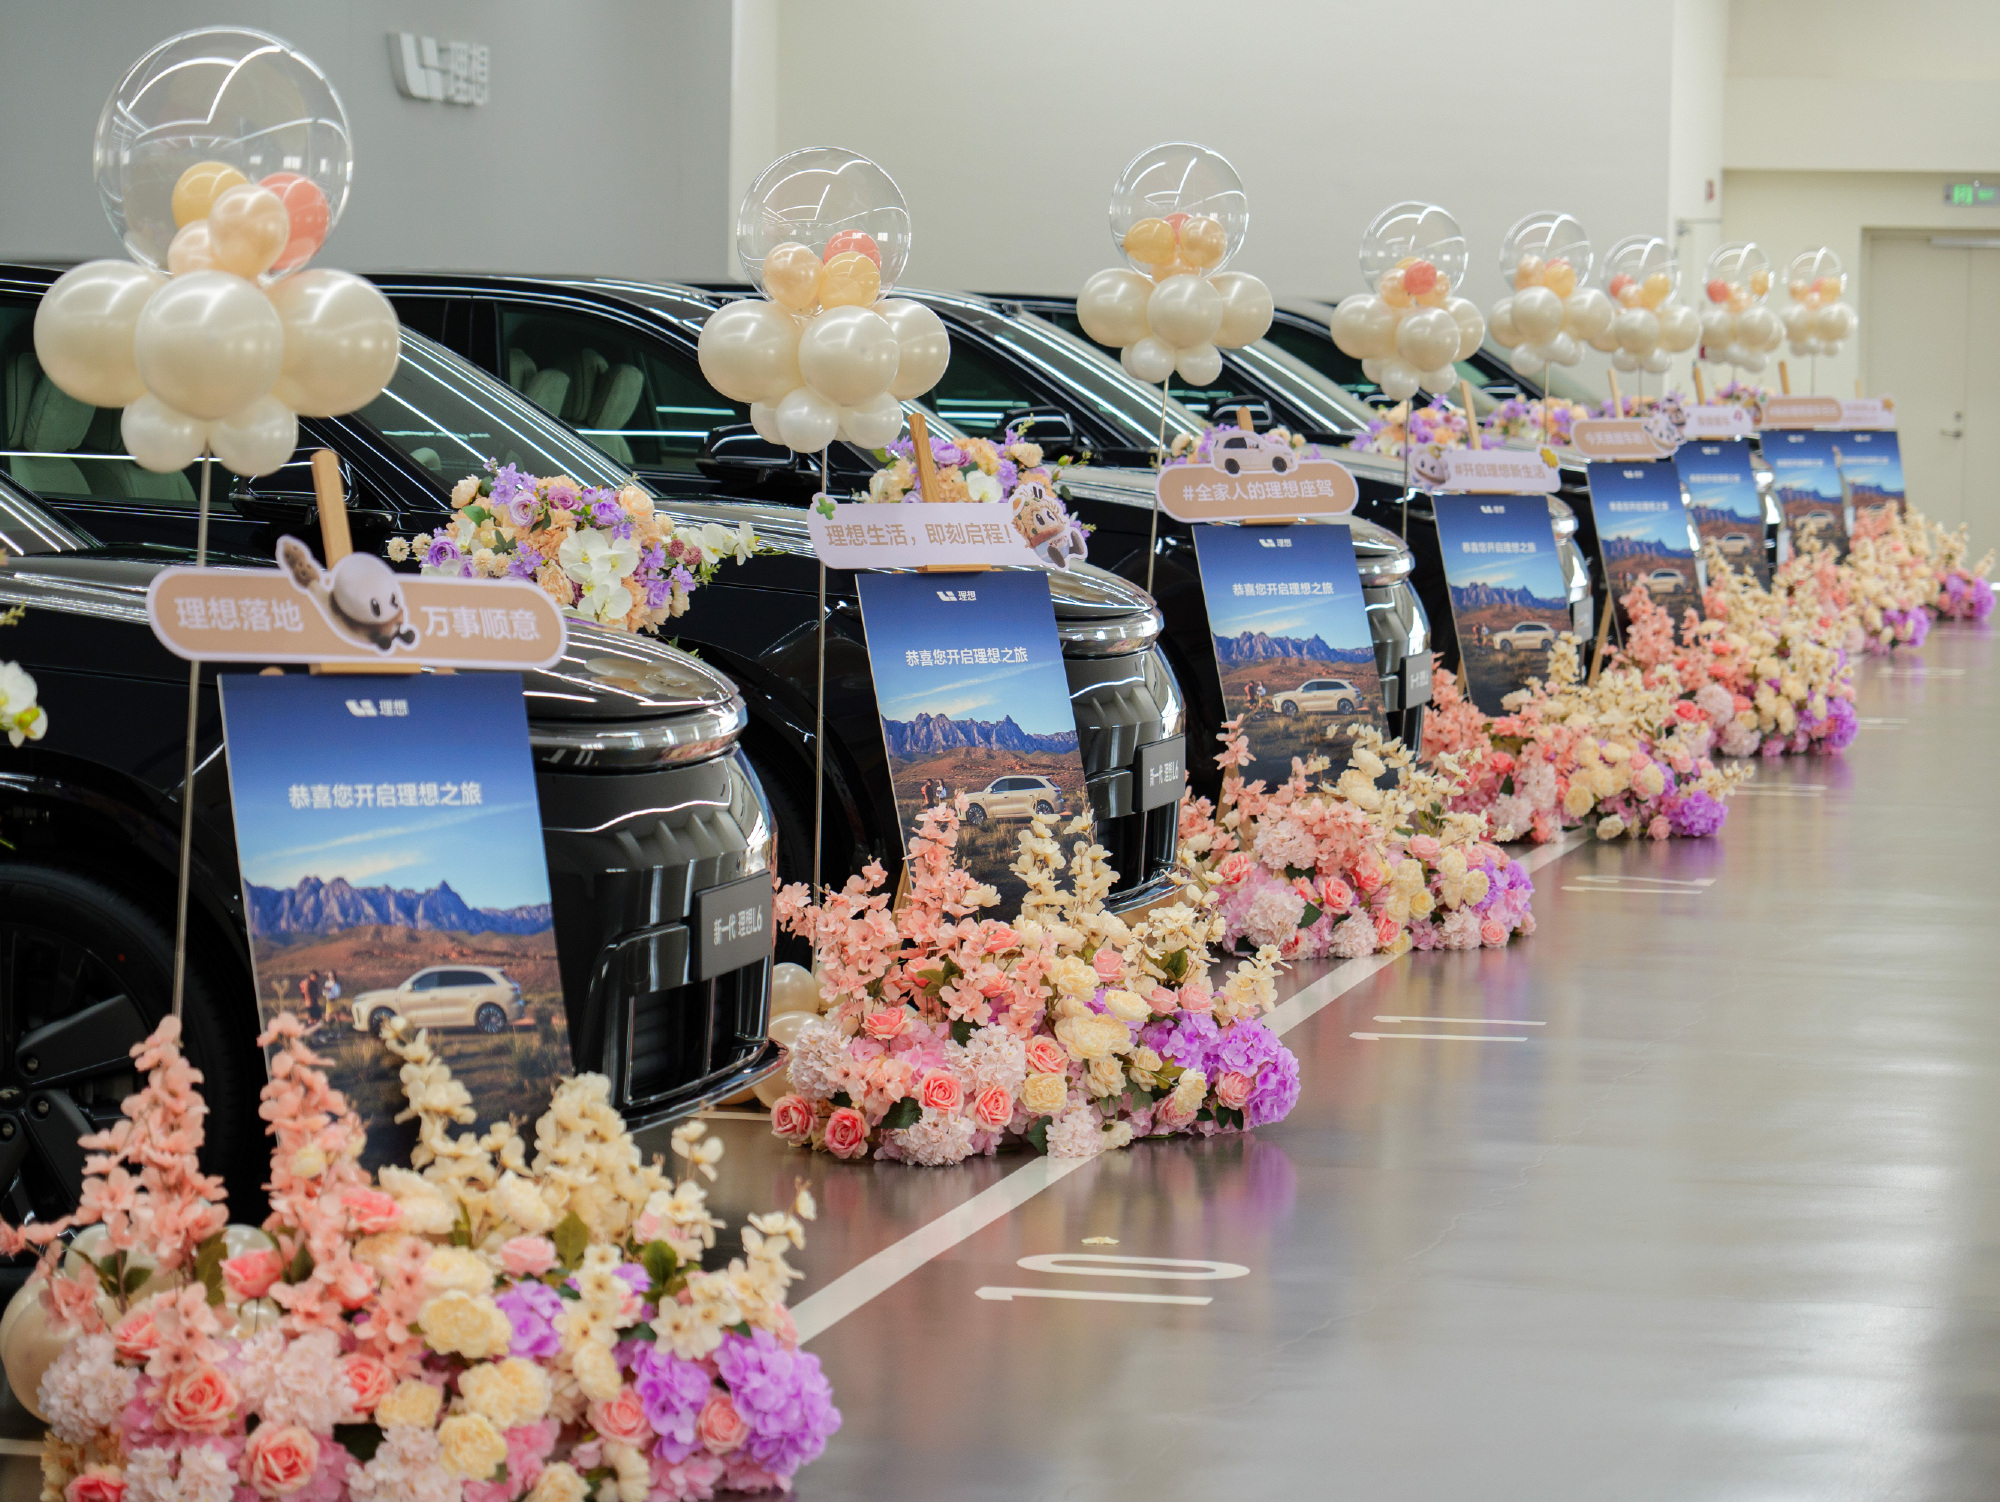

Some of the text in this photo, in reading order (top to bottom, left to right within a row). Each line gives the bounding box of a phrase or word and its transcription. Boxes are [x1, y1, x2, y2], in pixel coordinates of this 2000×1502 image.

[1182, 479, 1335, 502] #全家人的理想座驾
[957, 590, 977, 602] 理想
[1231, 582, 1335, 597] 恭喜您开启理想之旅
[174, 596, 541, 641] 理想落地 万事顺意
[905, 647, 1029, 667] 恭喜您开启理想之旅
[288, 781, 483, 809] 恭喜您开启理想之旅
[974, 1253, 1250, 1305] 10
